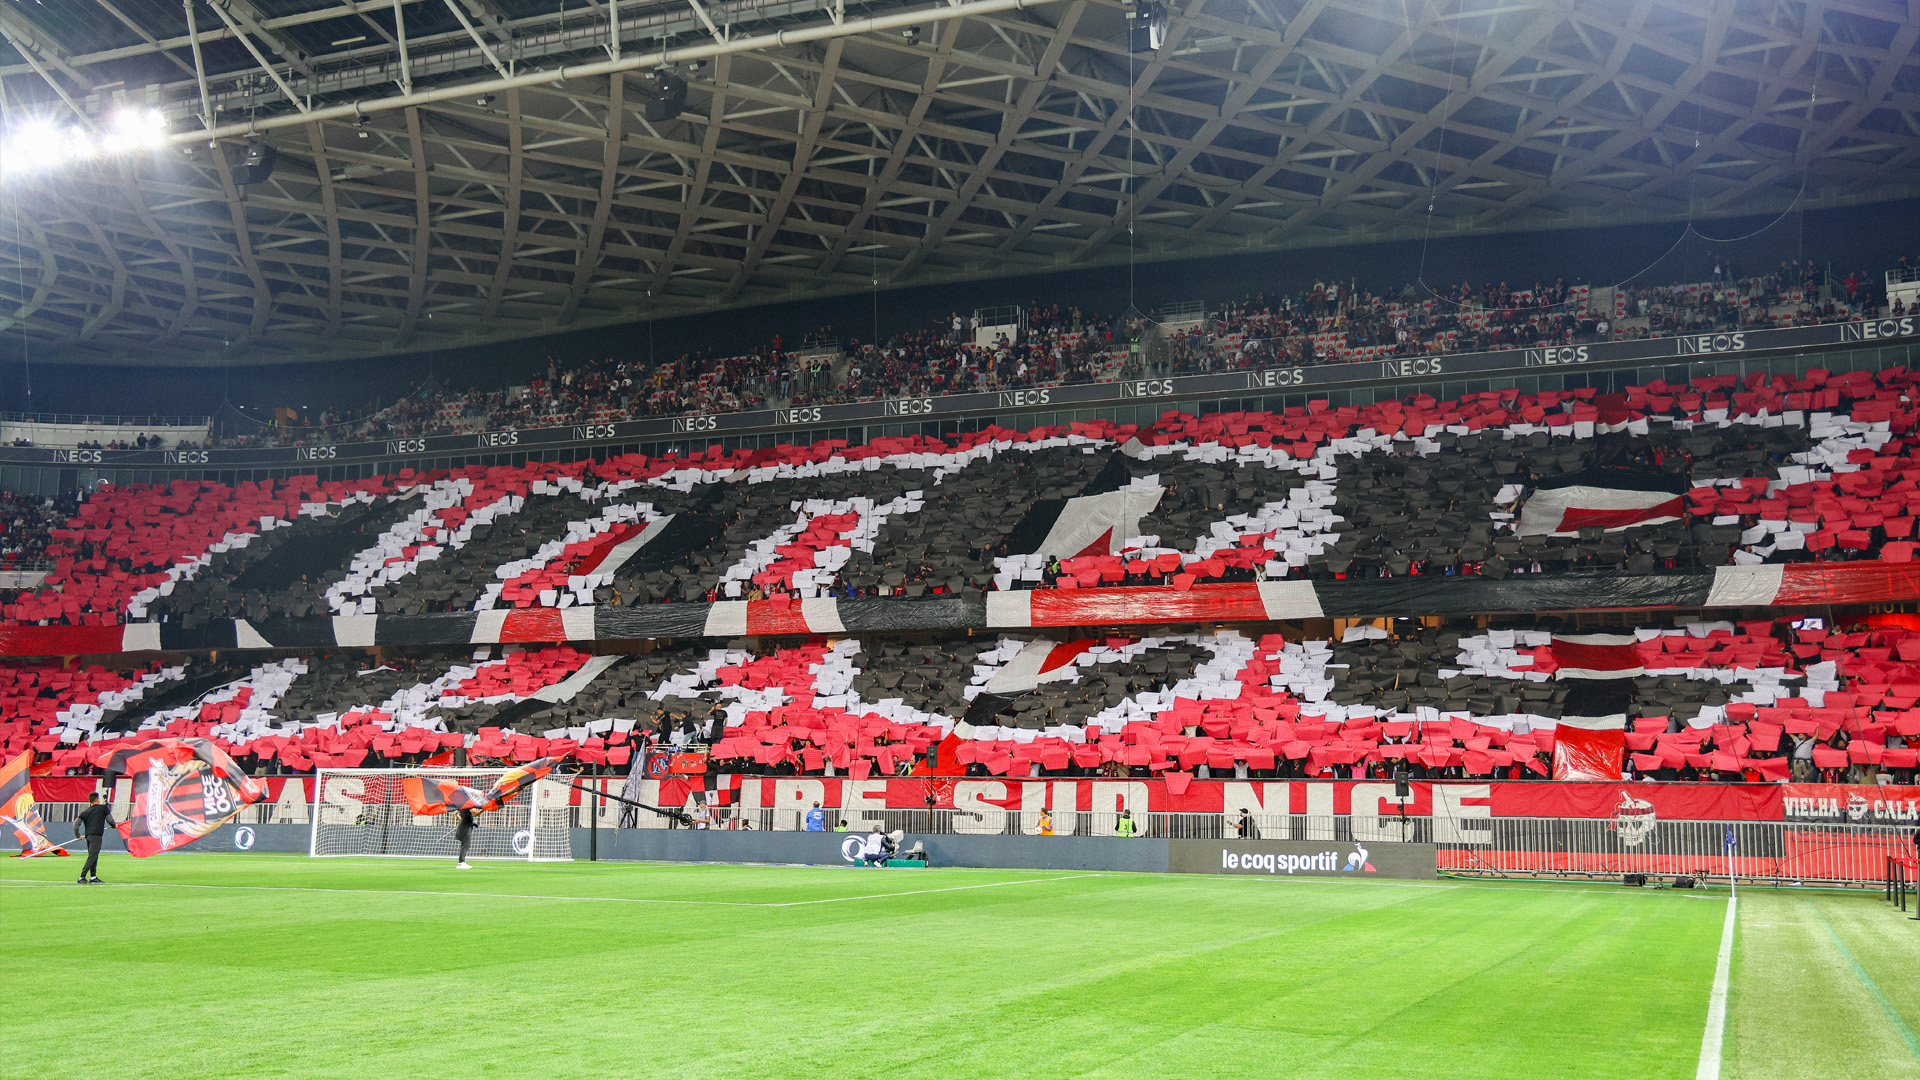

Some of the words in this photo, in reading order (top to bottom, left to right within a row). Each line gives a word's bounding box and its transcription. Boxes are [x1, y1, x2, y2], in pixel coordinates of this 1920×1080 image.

[1841, 319, 1914, 341] INEOS
[1677, 334, 1744, 354] INEOS
[1525, 346, 1588, 365] INEOS
[1382, 358, 1441, 377] INEOS
[1247, 369, 1303, 387] INEOS
[1120, 380, 1173, 397] INEOS
[999, 390, 1049, 406] INEOS
[885, 399, 932, 415] INEOS
[673, 416, 716, 432] INEOS
[776, 408, 821, 424] INEOS
[478, 432, 517, 446] INEOS
[574, 424, 615, 438] INEOS
[297, 446, 336, 459] INEOS
[387, 439, 425, 453] INEOS
[54, 450, 101, 462] INEOS
[165, 451, 208, 463] INEOS
[953, 780, 1149, 837] SUD
[1224, 782, 1492, 843] NICE
[1783, 797, 1840, 817] VIELHA
[1874, 800, 1919, 820] CALA
[1223, 850, 1238, 868] le
[1242, 854, 1275, 873] coq
[1277, 851, 1338, 873] sportif
